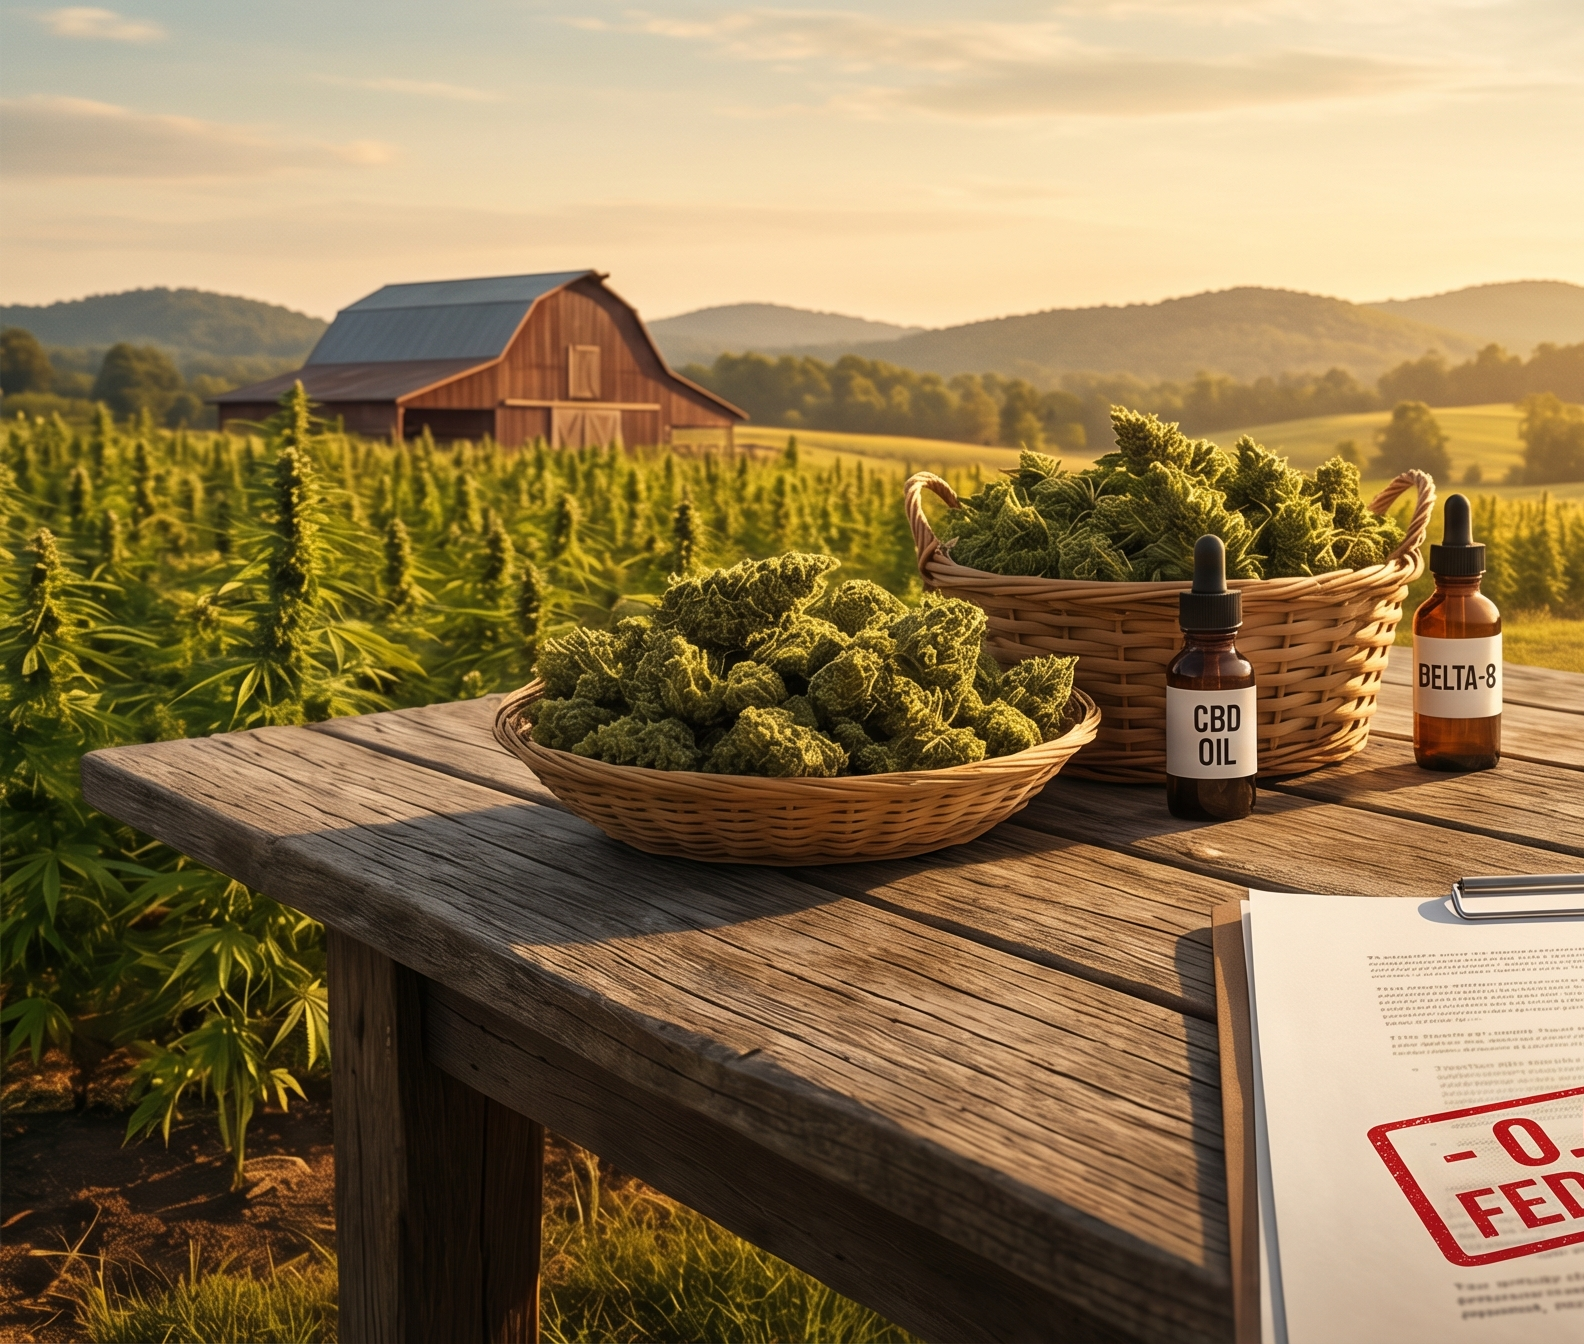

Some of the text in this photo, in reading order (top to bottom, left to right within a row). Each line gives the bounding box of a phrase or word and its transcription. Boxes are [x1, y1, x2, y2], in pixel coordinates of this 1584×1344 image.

[1418, 662, 1497, 691] BELTA-8
[1193, 703, 1241, 733] CBD
[1198, 737, 1237, 766] OIL
